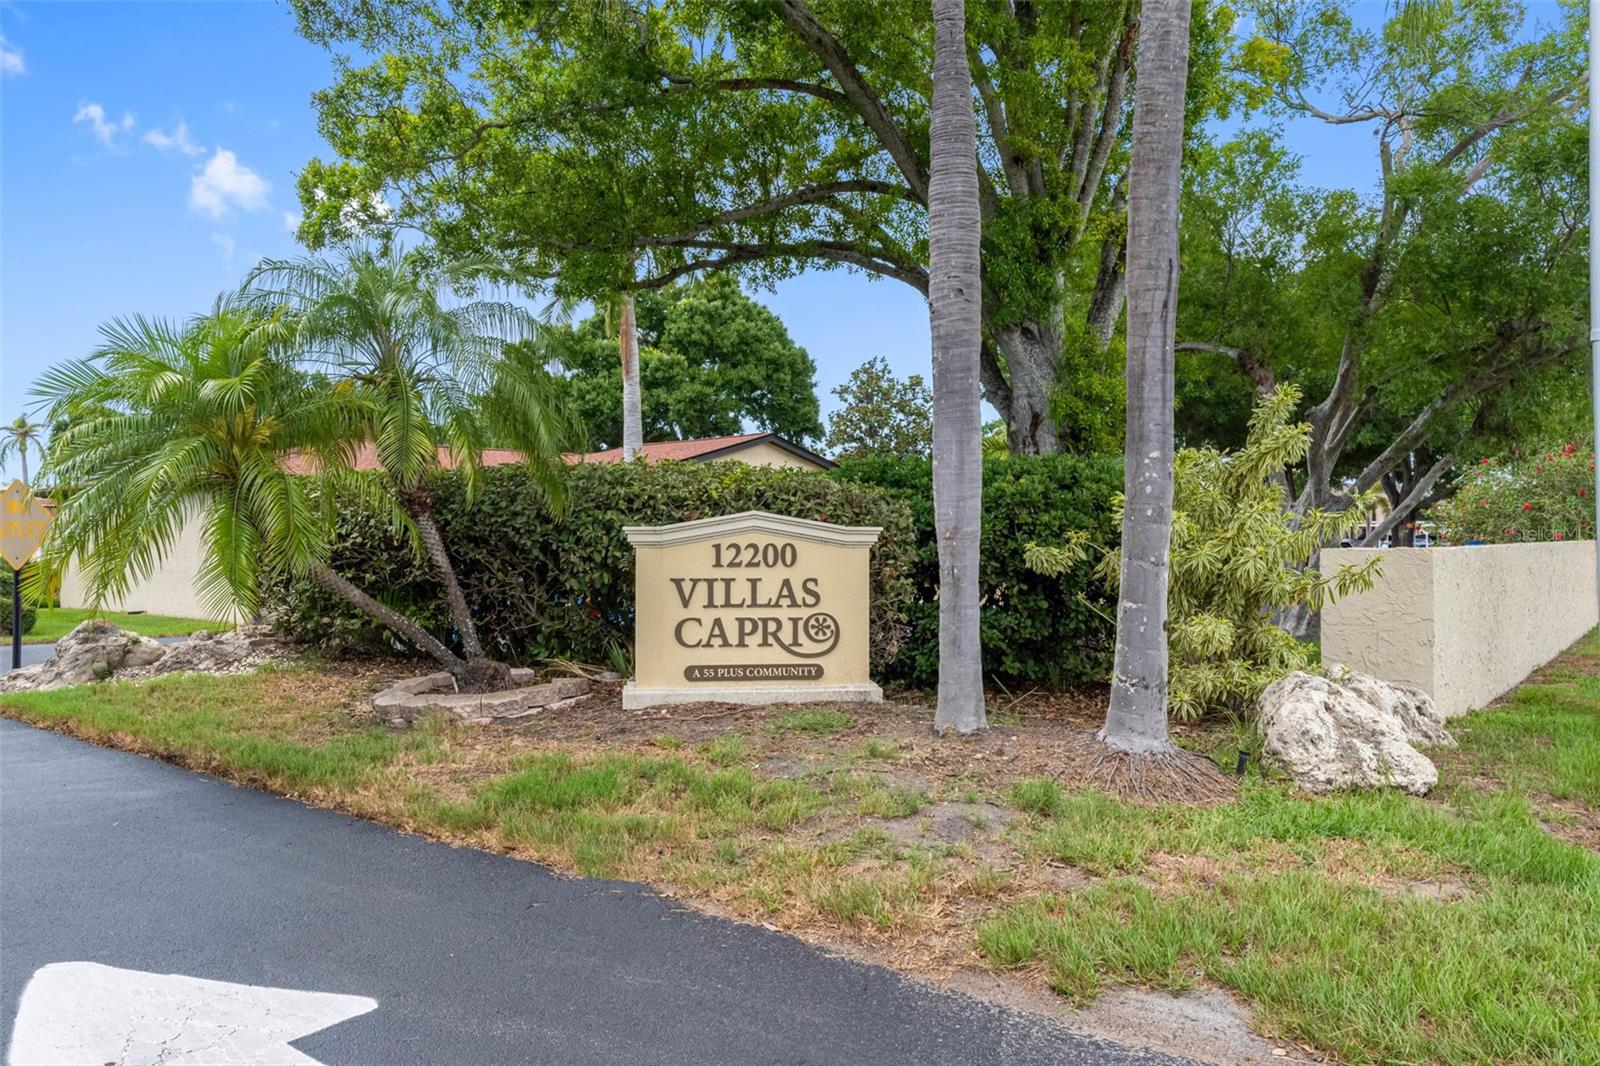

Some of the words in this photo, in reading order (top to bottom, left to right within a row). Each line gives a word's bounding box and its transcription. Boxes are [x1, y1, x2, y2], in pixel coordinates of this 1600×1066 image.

[711, 542, 798, 569] 12200
[669, 577, 822, 609] VILLAS
[674, 612, 841, 659] CAPRI
[692, 669, 701, 678] A
[703, 669, 715, 678] 55
[717, 668, 744, 678] PLUS
[746, 667, 817, 677] COMMUNITY
